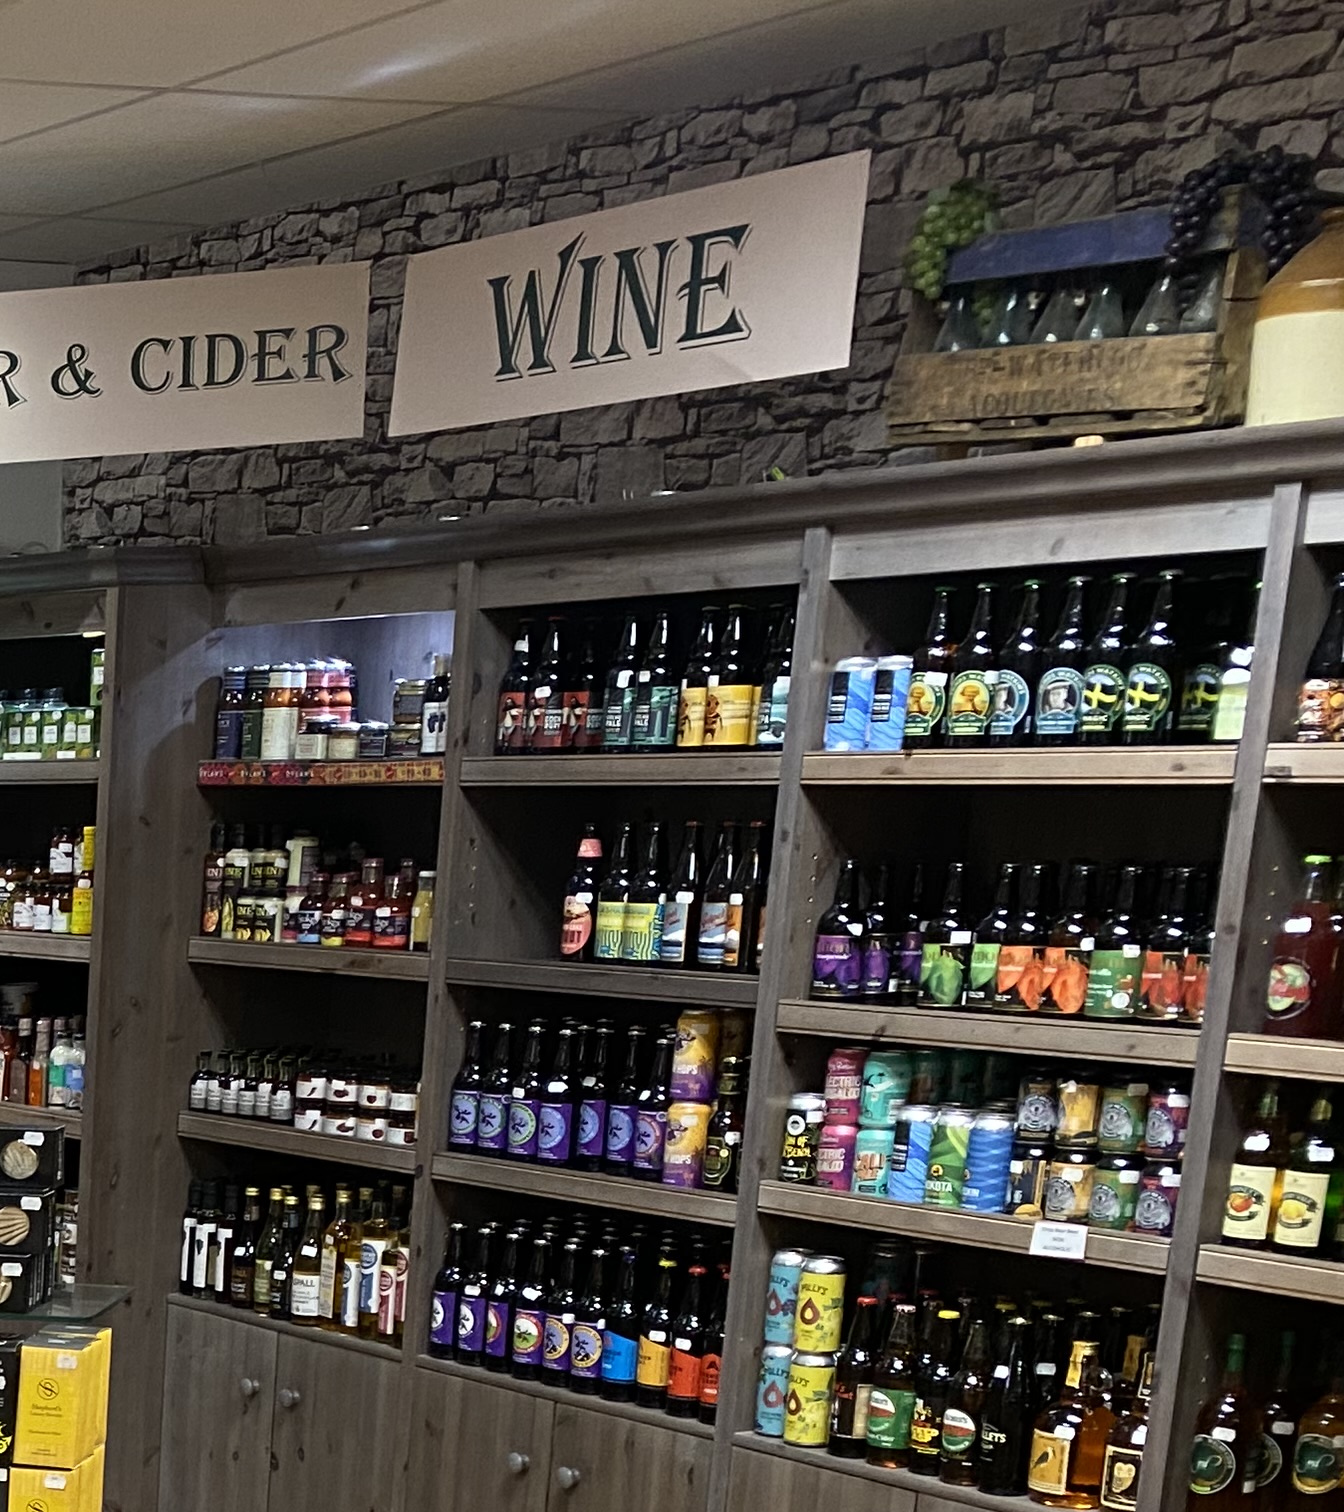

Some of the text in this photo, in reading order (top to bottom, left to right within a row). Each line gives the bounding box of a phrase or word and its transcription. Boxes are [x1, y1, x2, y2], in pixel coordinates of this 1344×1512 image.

[50, 342, 101, 399] &
[132, 321, 353, 394] CIDER
[488, 222, 753, 380] WINE
